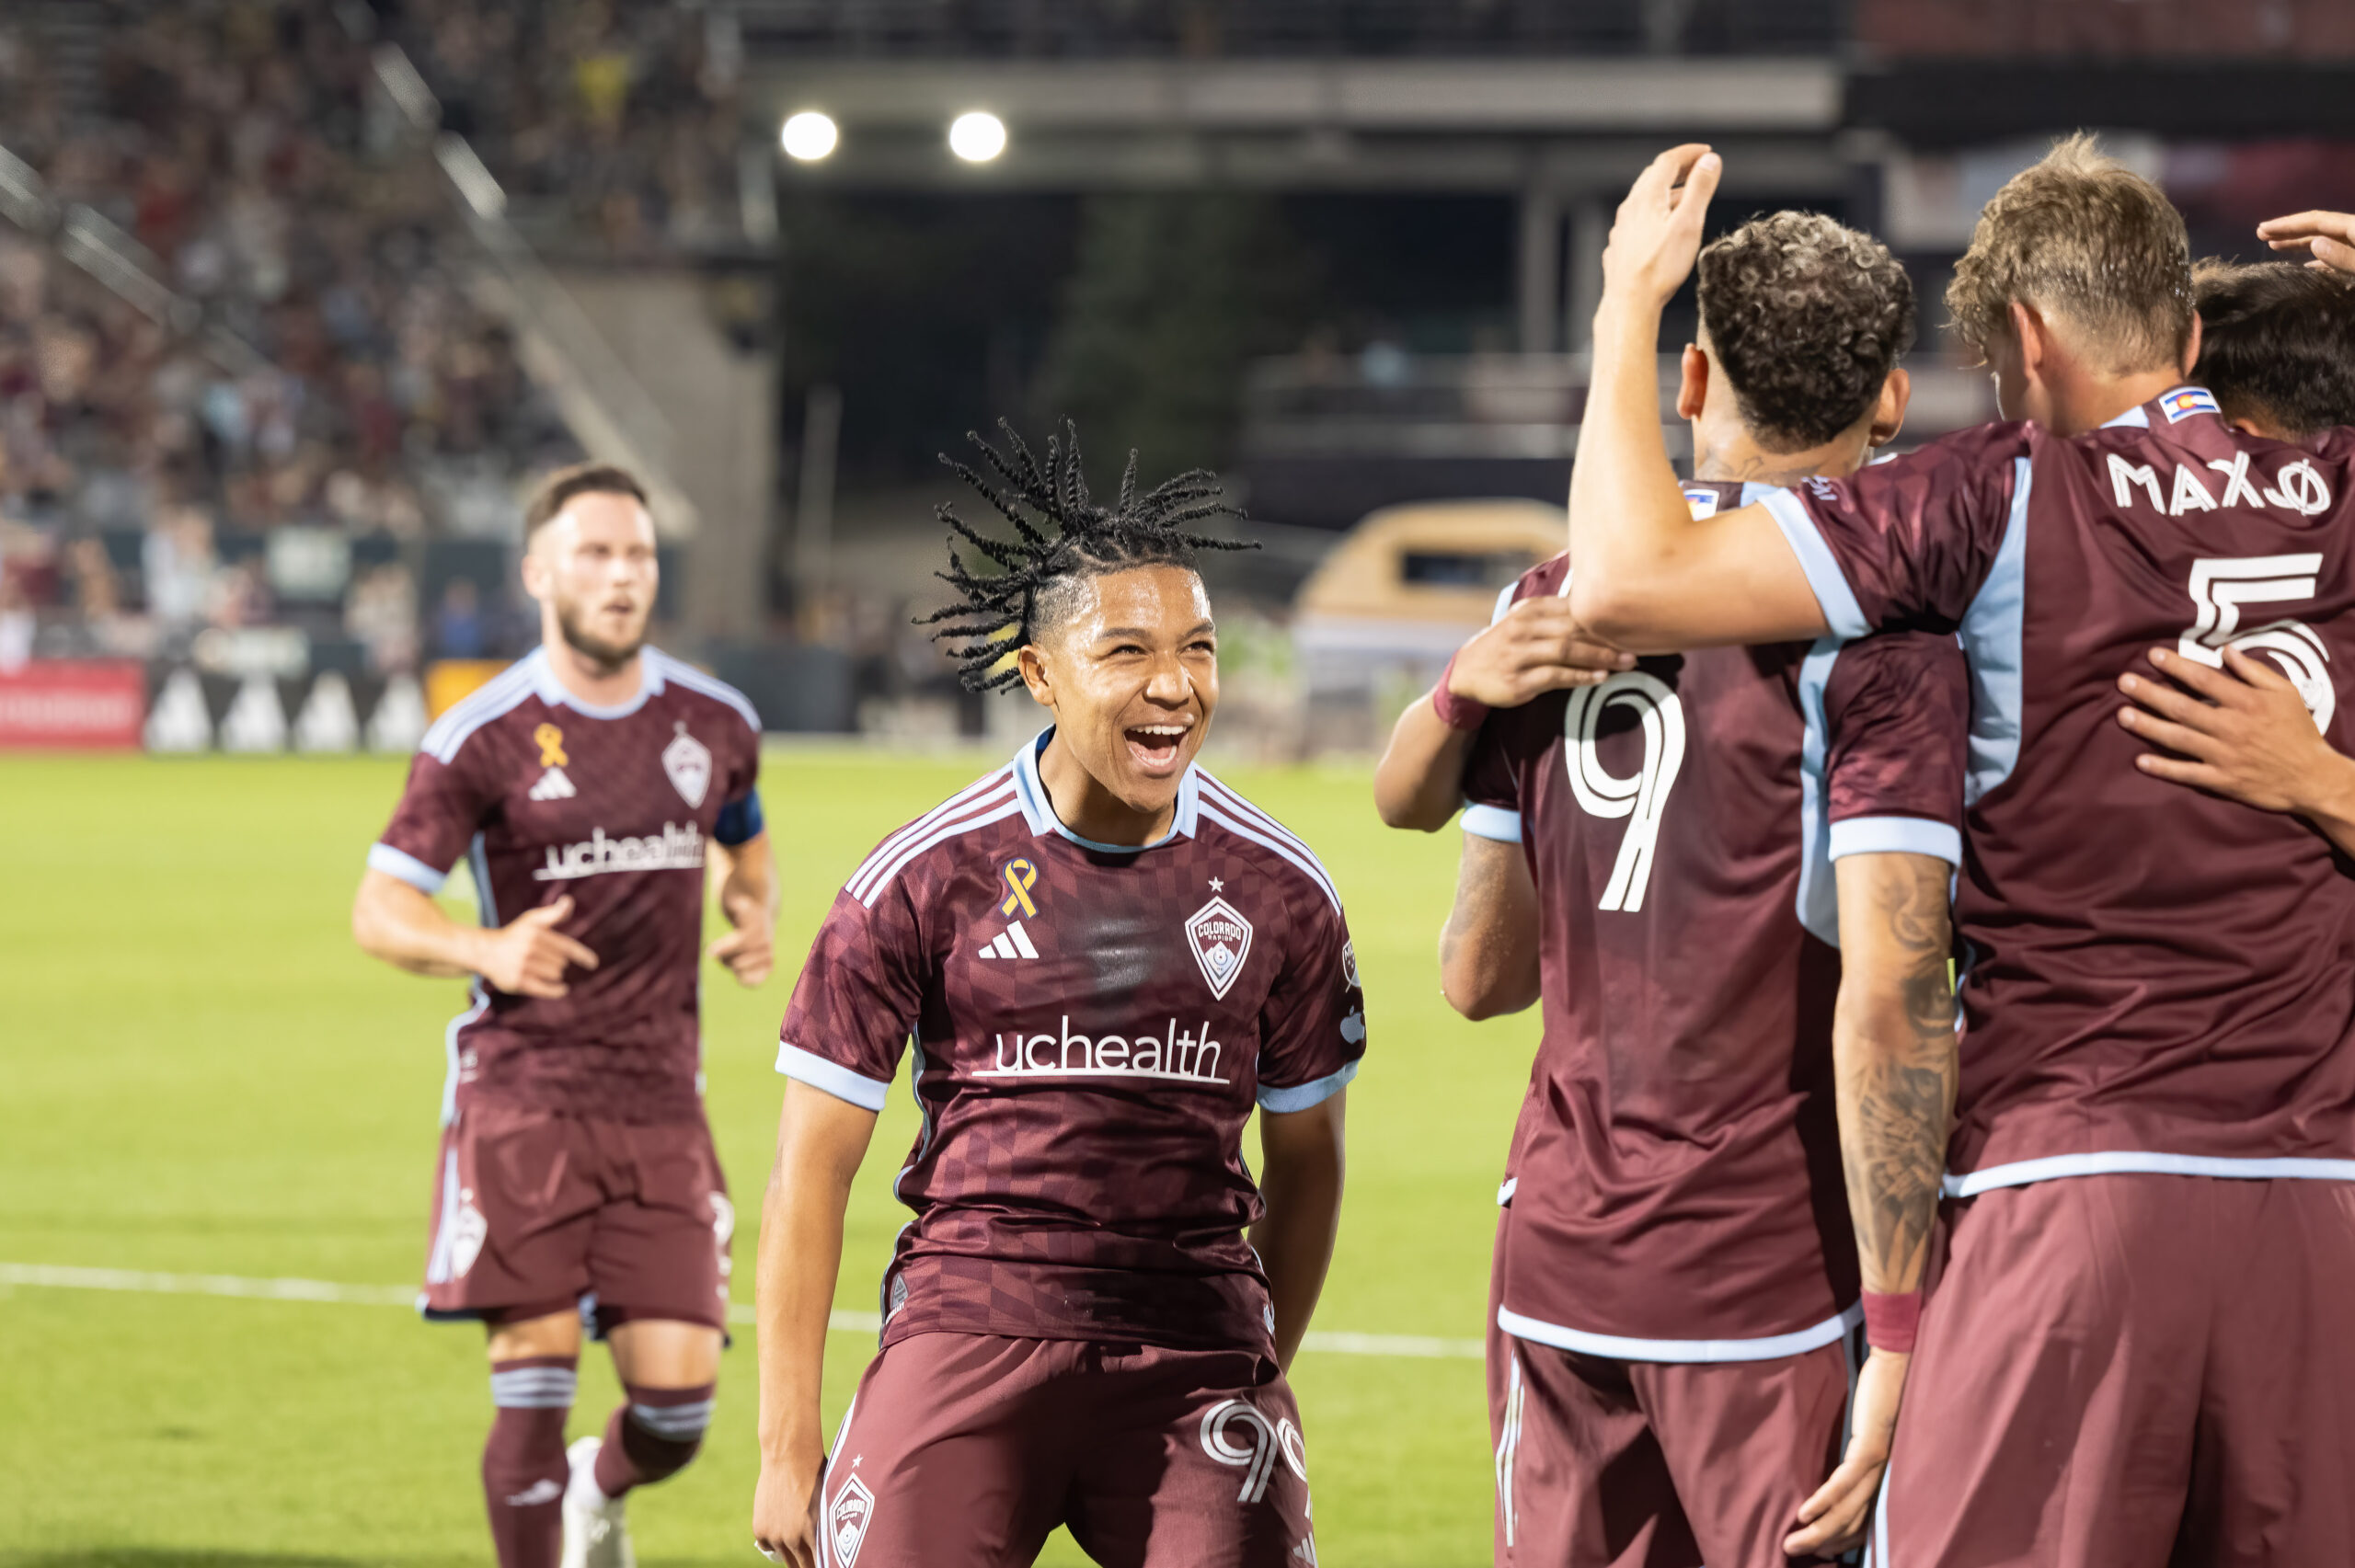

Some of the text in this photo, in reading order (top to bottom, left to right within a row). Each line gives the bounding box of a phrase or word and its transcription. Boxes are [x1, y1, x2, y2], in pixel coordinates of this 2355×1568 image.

[2178, 553, 2336, 736] 5
[1565, 671, 1686, 912] 9
[545, 819, 705, 876] uchealth
[1198, 921, 1242, 941] COLORADO
[995, 1014, 1223, 1080] uchealth
[1200, 1399, 1313, 1522] 99
